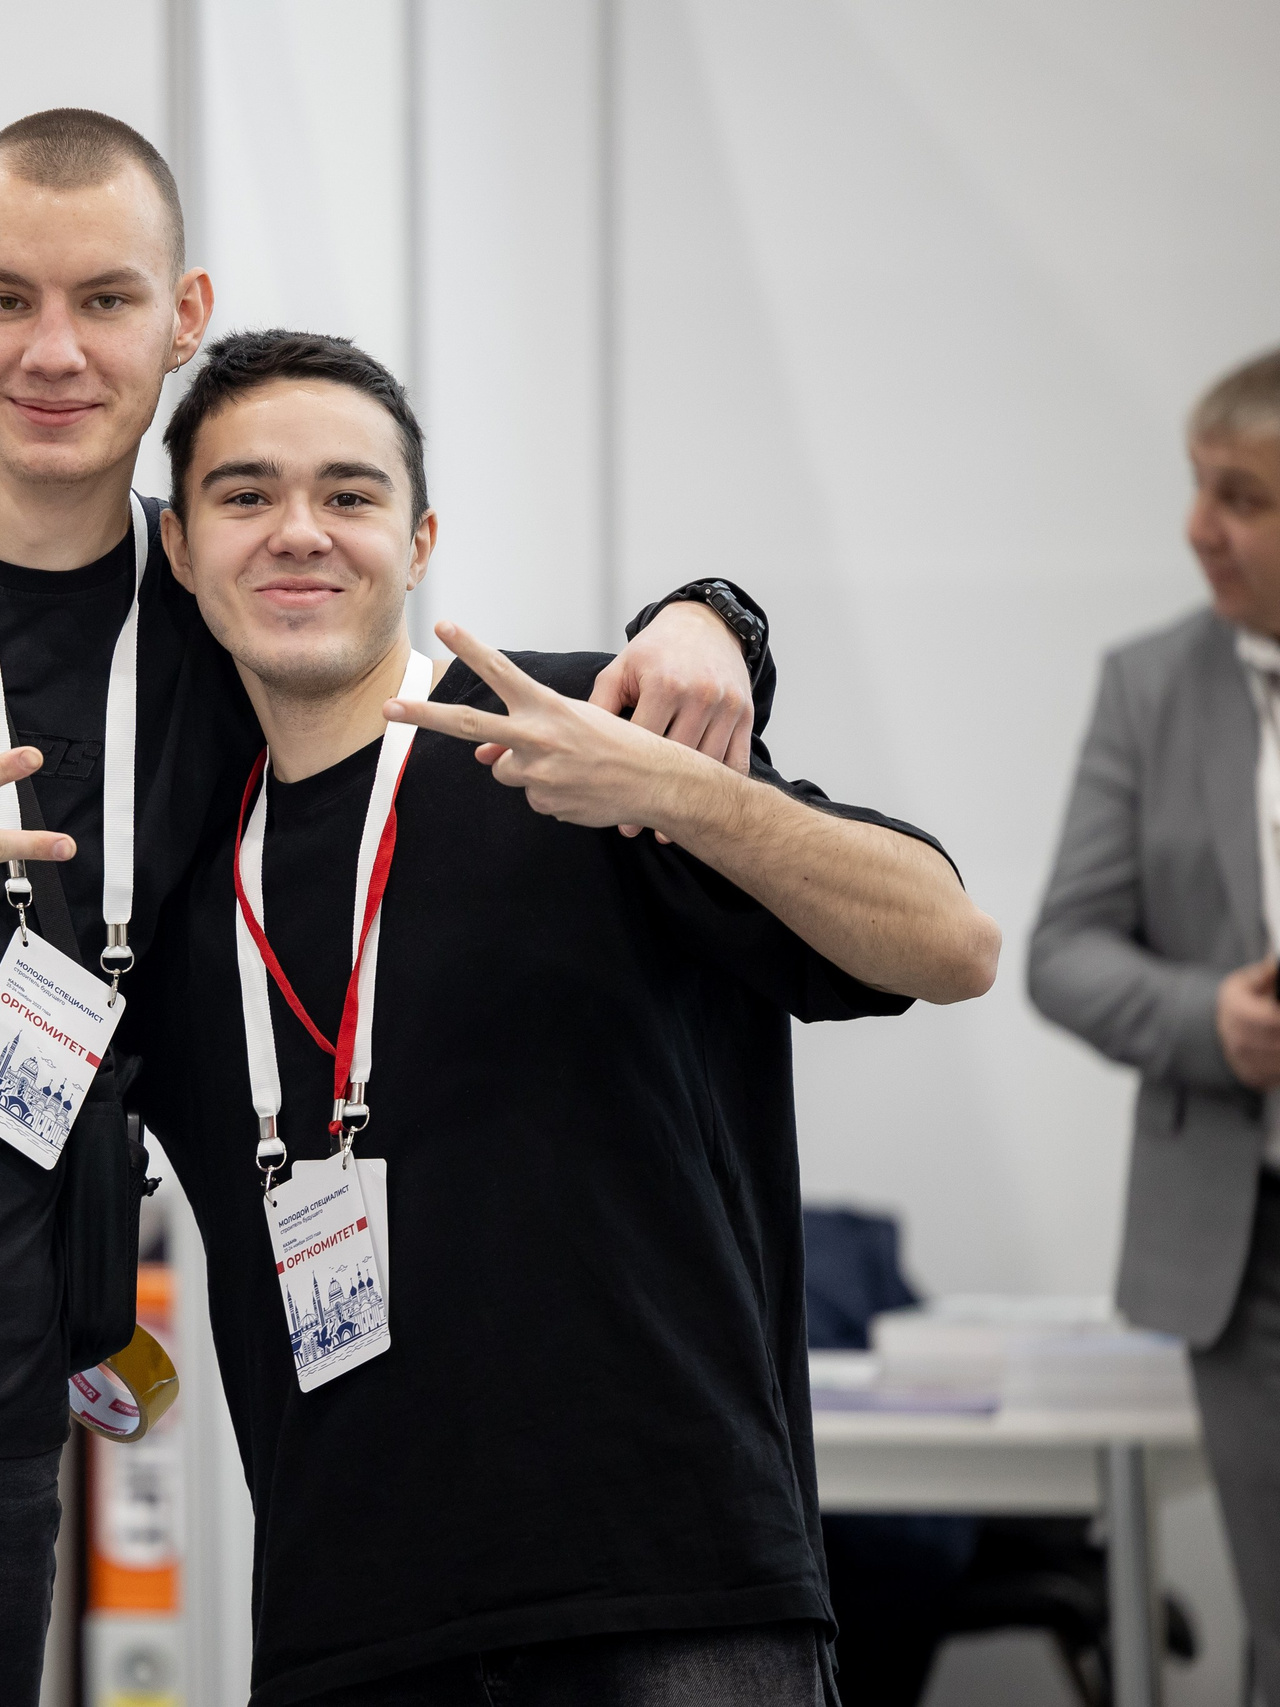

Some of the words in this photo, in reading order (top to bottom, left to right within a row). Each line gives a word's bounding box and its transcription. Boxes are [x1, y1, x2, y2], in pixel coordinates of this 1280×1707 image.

[16, 959, 54, 989] МОЛОДОЙ
[54, 986, 104, 1024] СПЕЦИАЛИСТ
[0, 992, 87, 1057] ОРГКОМИТЕТ
[278, 1205, 310, 1228] МОЛОДОЙ
[309, 1184, 350, 1211] СПЕЦИАЛИСТ
[286, 1223, 355, 1269] ОРГКОМИТЕТ
